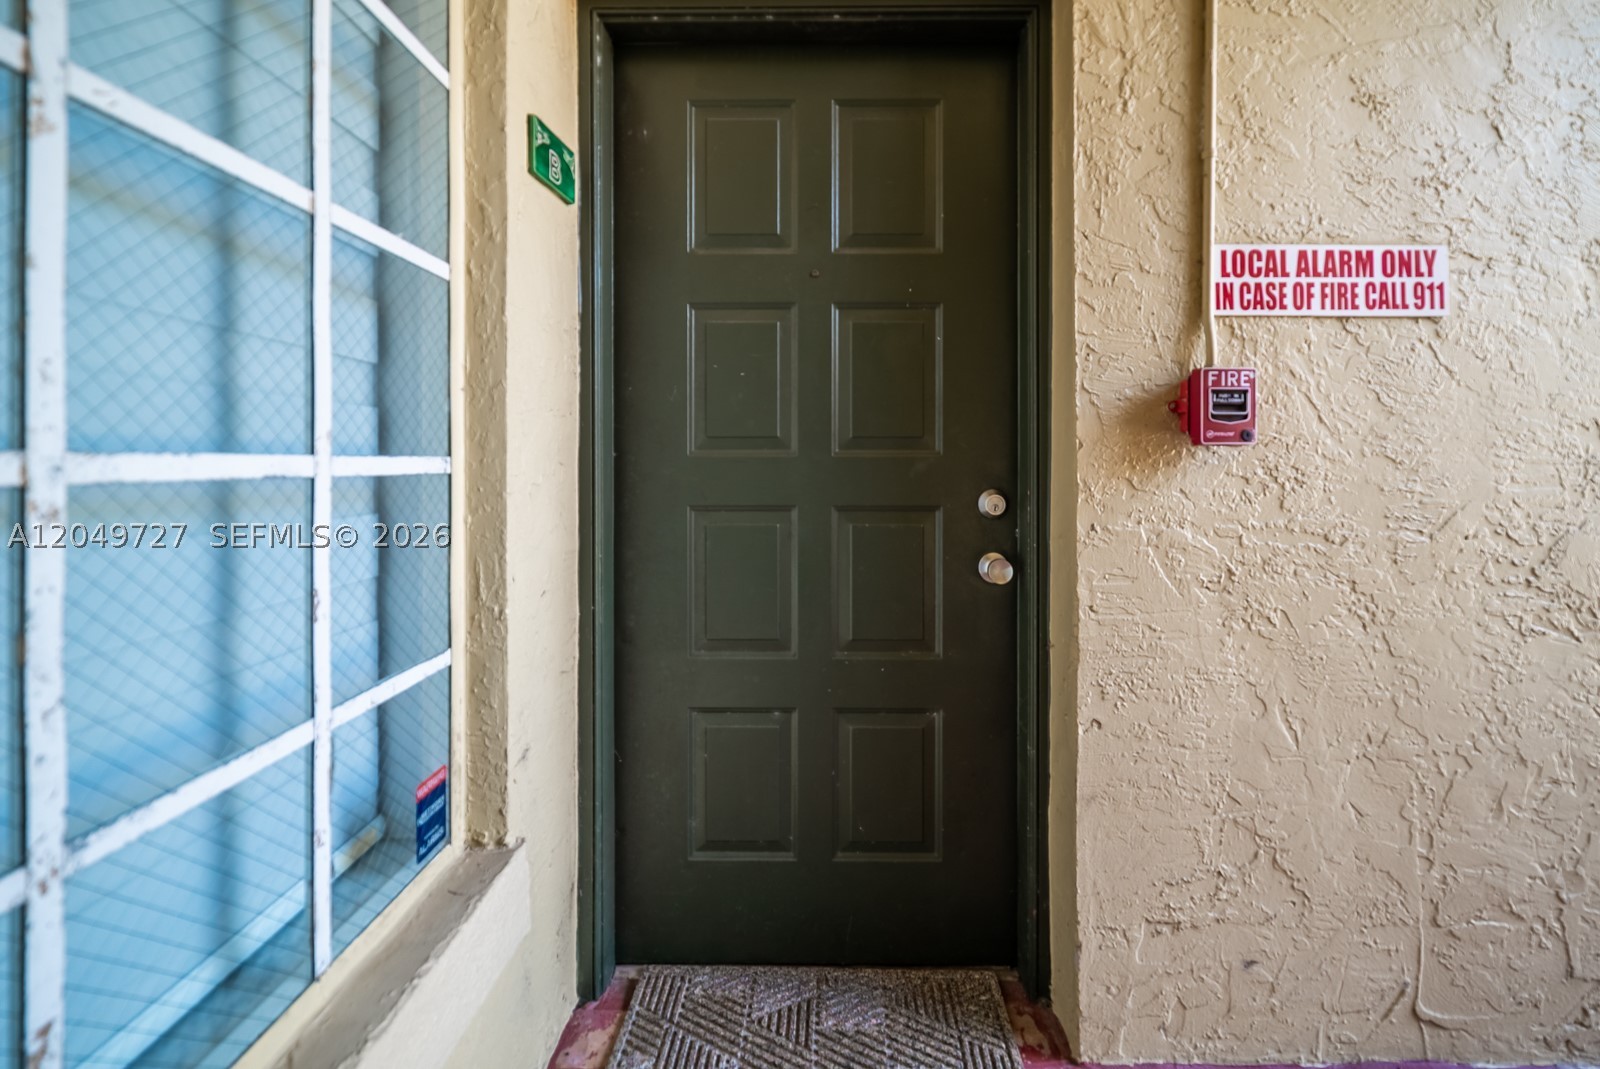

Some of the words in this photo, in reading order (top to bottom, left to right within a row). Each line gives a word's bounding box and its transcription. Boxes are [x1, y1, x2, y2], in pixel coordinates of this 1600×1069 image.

[1220, 249, 1290, 278] LOCAL
[1296, 249, 1375, 278] ALARM
[1381, 249, 1437, 278] ONLY
[1215, 282, 1234, 310] IN
[1239, 282, 1288, 311] CASE
[1292, 282, 1315, 310] OF
[1320, 282, 1359, 310] FIRE
[1364, 281, 1409, 310] CALL
[1413, 281, 1445, 310] 911
[1208, 370, 1251, 387] FIRE
